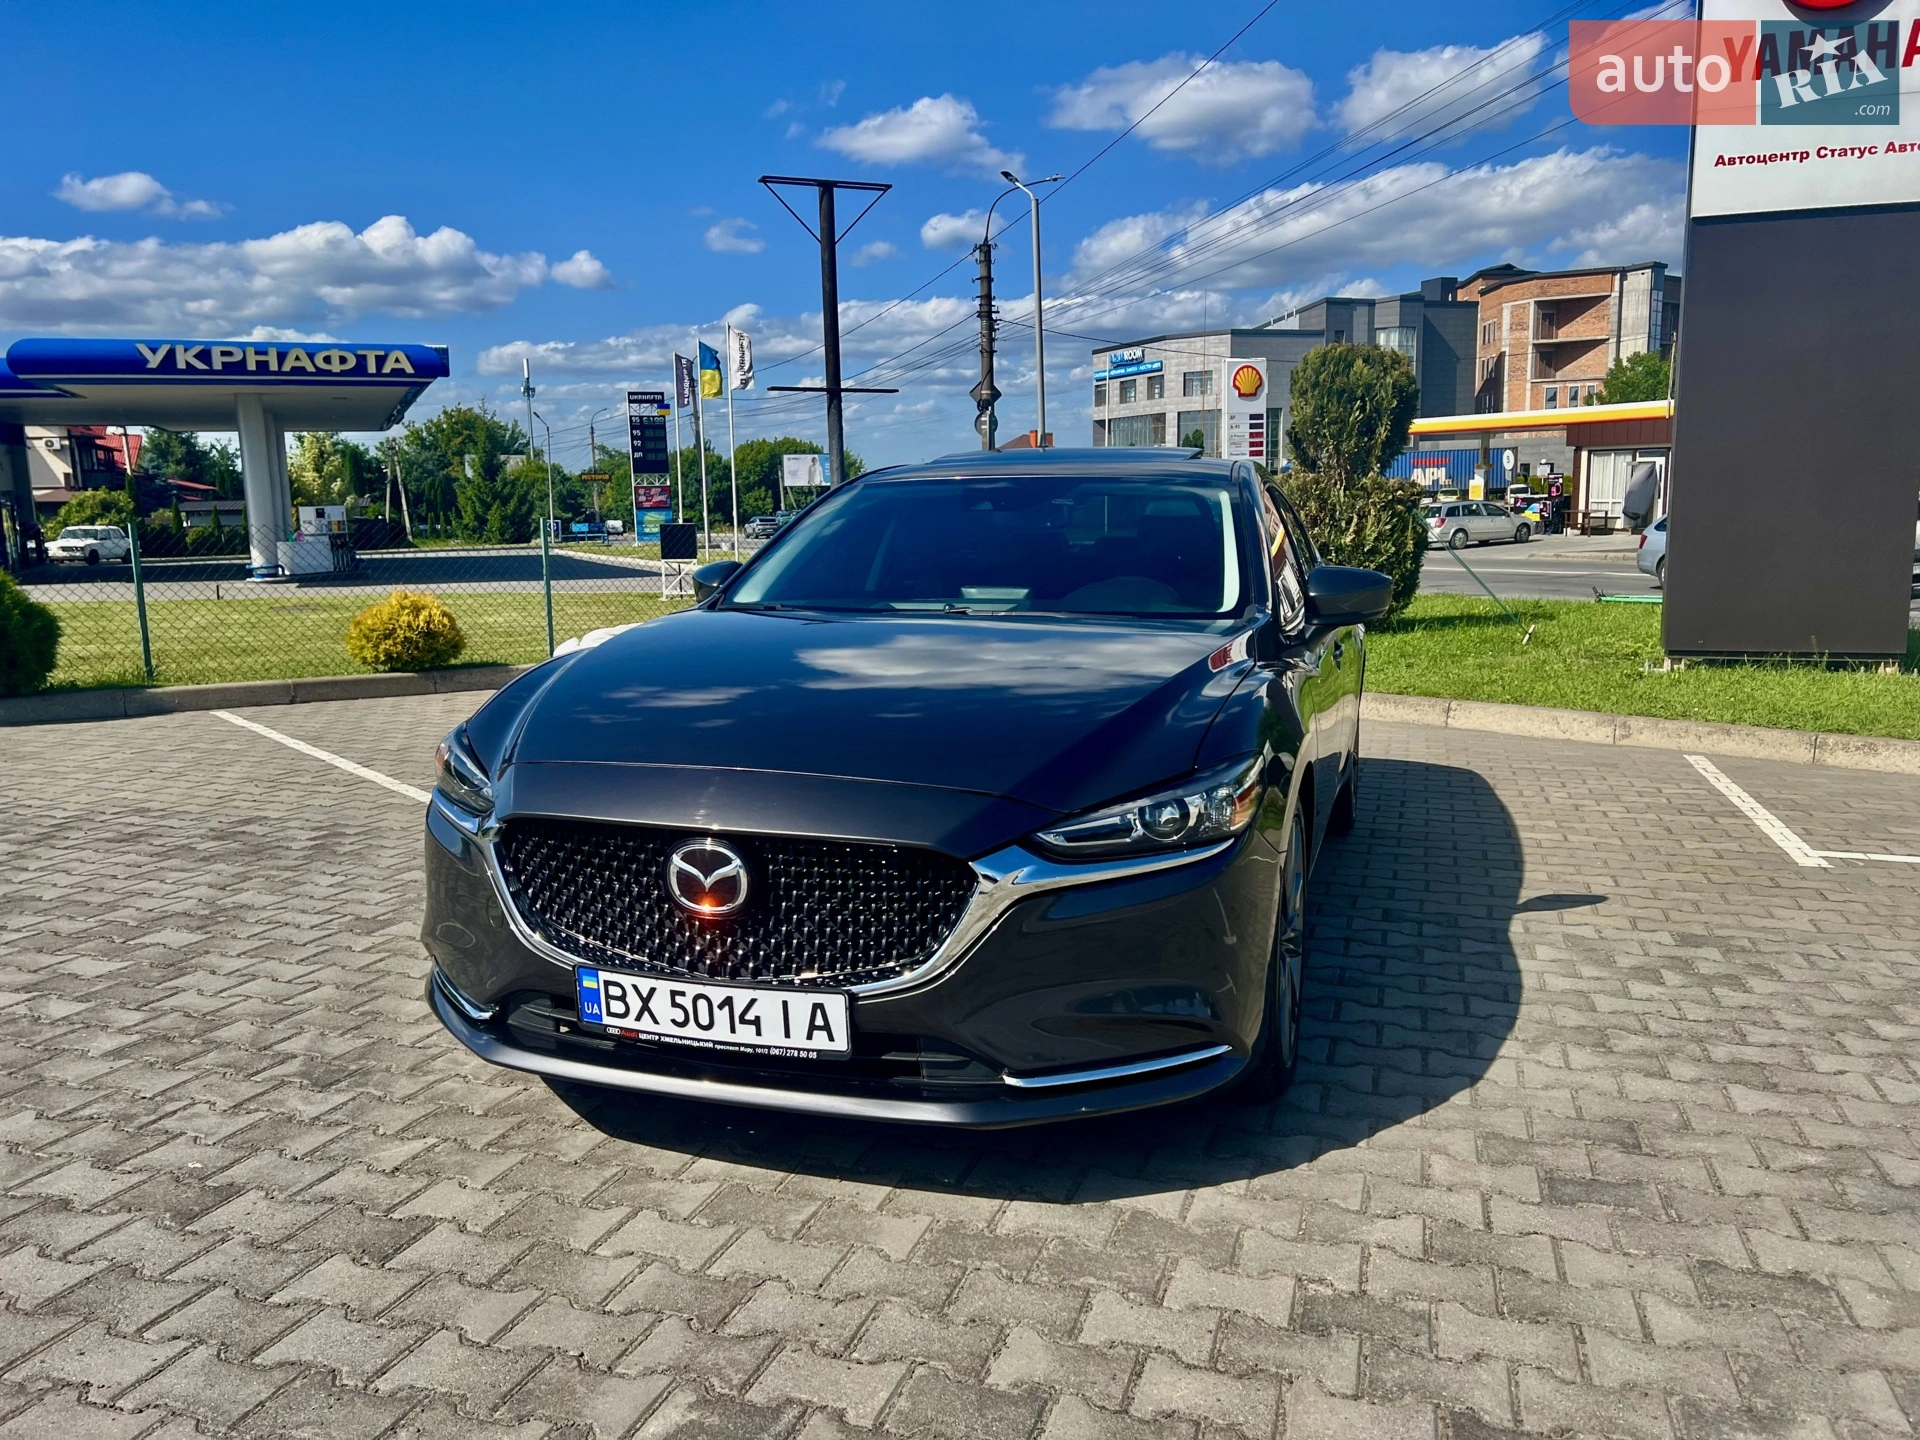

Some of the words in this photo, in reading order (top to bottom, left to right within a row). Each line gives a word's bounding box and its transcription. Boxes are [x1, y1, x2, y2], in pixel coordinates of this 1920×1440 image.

[1714, 149, 1810, 167] Автоцентр
[1816, 142, 1879, 160] Статус
[1884, 140, 1920, 154] Авт
[135, 343, 415, 374] УКРНАФТА
[1506, 455, 1511, 464] 5
[584, 1001, 601, 1015] UA
[669, 989, 763, 1038] 5014
[620, 1029, 638, 1038] Audi
[638, 1033, 660, 1041] ЦЕНТР
[660, 1036, 714, 1048] ХМЕЛЬНИЦЬКИЙ
[769, 1047, 786, 1056] (067)
[786, 1049, 799, 1057] 278
[799, 1050, 808, 1058] 50
[808, 1051, 818, 1059] 05
